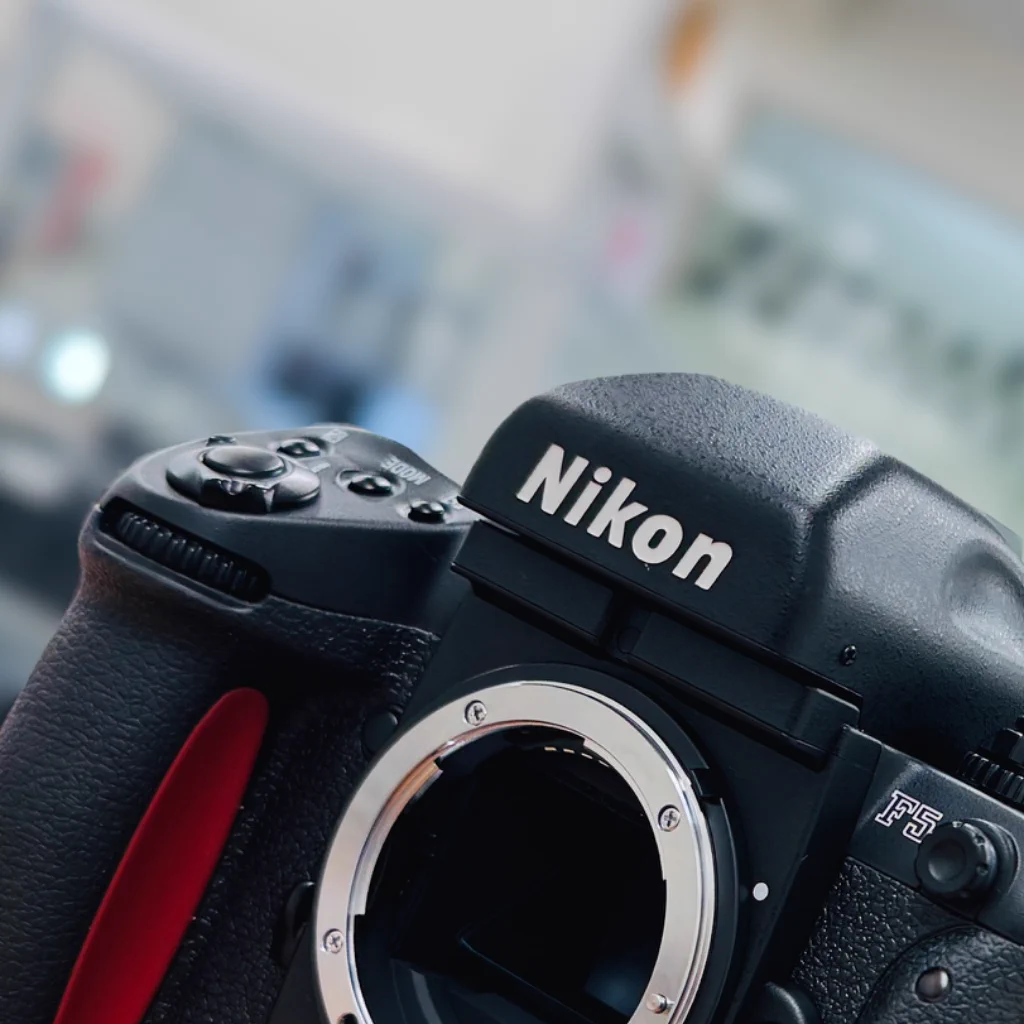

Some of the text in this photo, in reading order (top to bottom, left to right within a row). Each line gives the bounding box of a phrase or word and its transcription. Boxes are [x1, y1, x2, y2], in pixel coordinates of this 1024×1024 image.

[380, 455, 431, 485] MODE
[515, 443, 733, 591] Nikon
[875, 789, 943, 843] F5
